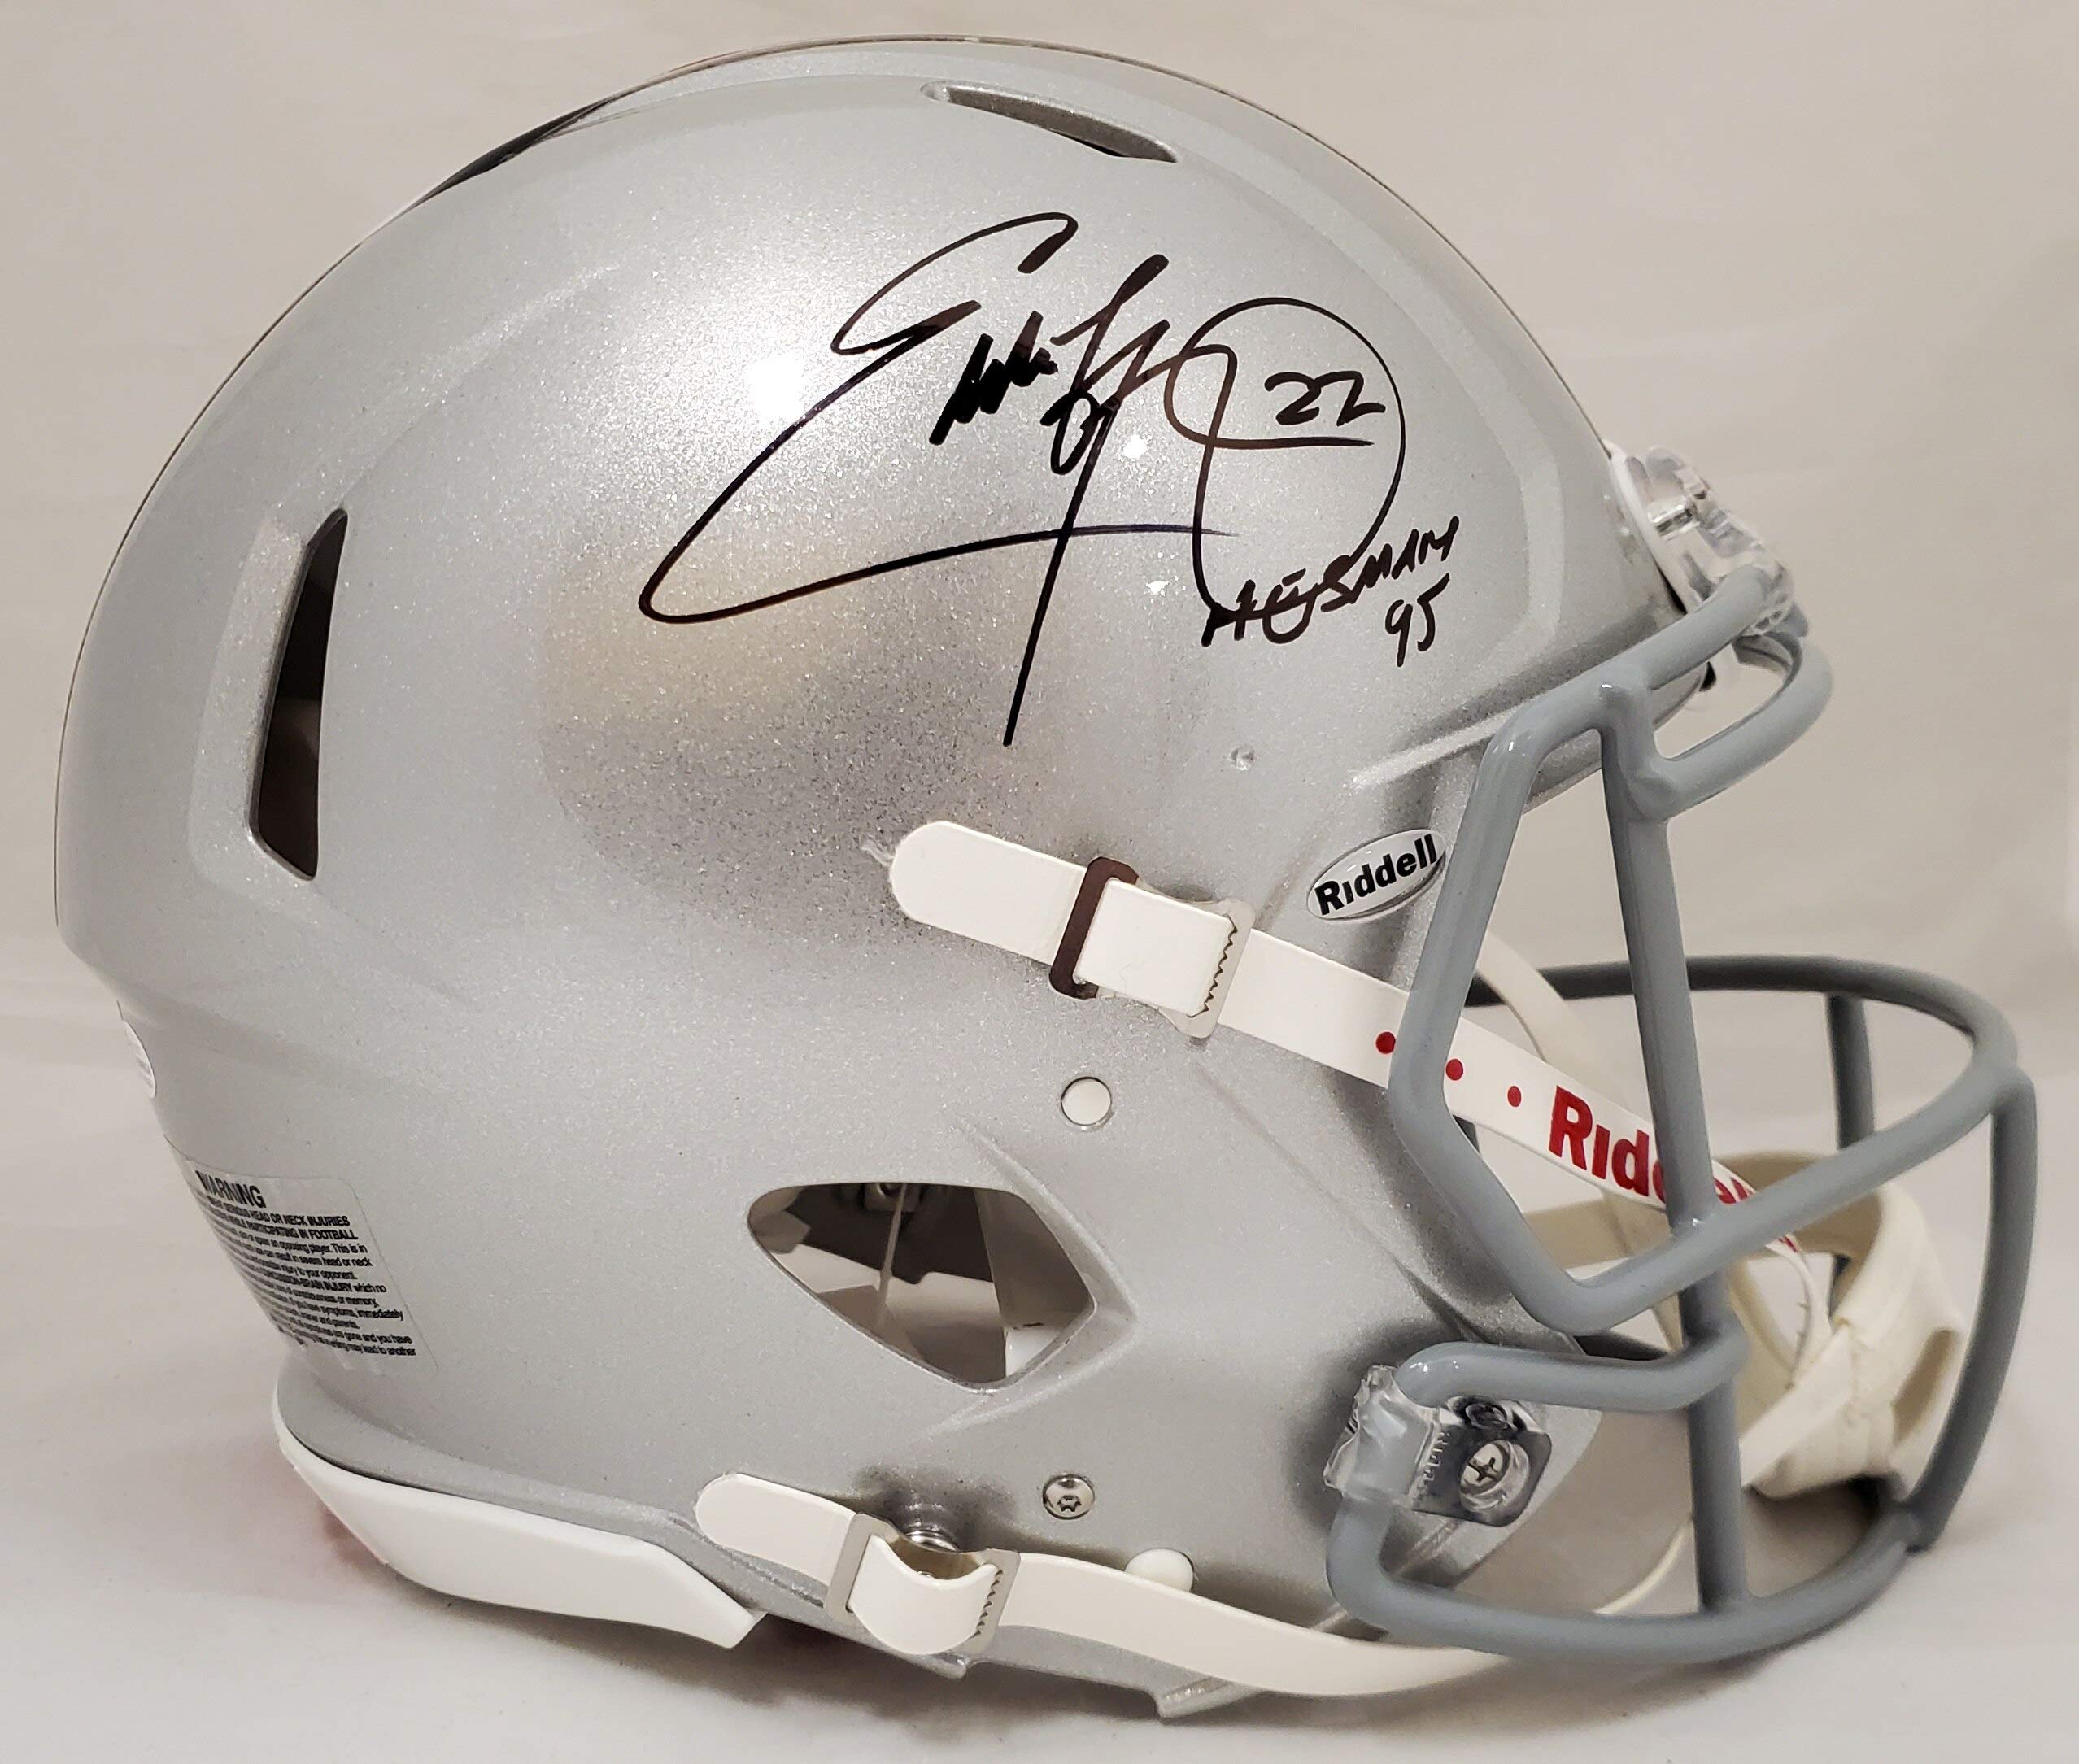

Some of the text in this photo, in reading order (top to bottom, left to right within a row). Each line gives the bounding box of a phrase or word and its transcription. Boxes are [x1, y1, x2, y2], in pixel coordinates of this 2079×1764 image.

[1265, 370, 1386, 427] 22
[1385, 572, 1451, 668] 95
[1314, 833, 1438, 916] Riddell
[194, 1169, 267, 1209] WARNING
[282, 1214, 307, 1226] NECK
[307, 1215, 351, 1226] INJURIES
[357, 1243, 368, 1253] in
[342, 1258, 351, 1266] or
[351, 1257, 373, 1266] neck
[322, 1281, 387, 1293] INJURY which no
[390, 1334, 412, 1344] have
